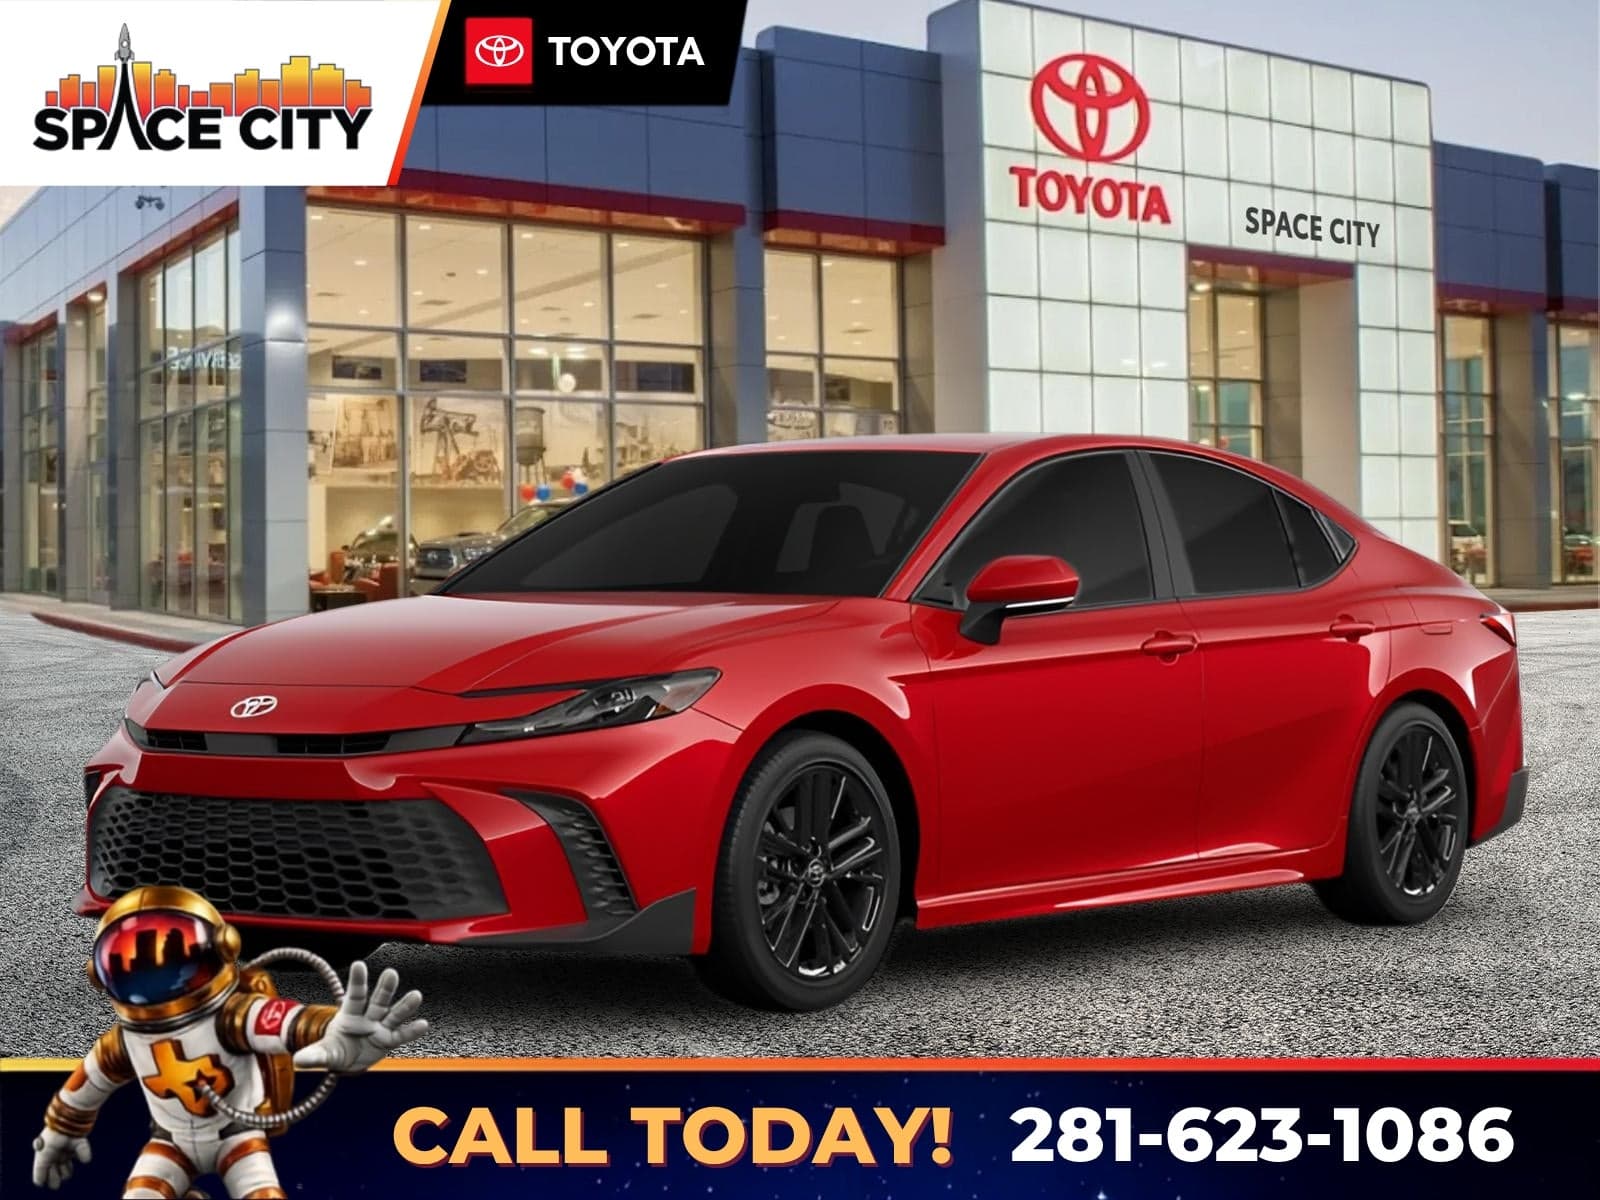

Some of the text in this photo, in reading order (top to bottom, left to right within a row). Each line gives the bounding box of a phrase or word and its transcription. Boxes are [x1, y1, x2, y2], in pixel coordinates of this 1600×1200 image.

[1010, 166, 1171, 224] TOYOTA
[1246, 206, 1380, 248] SPACE CITY
